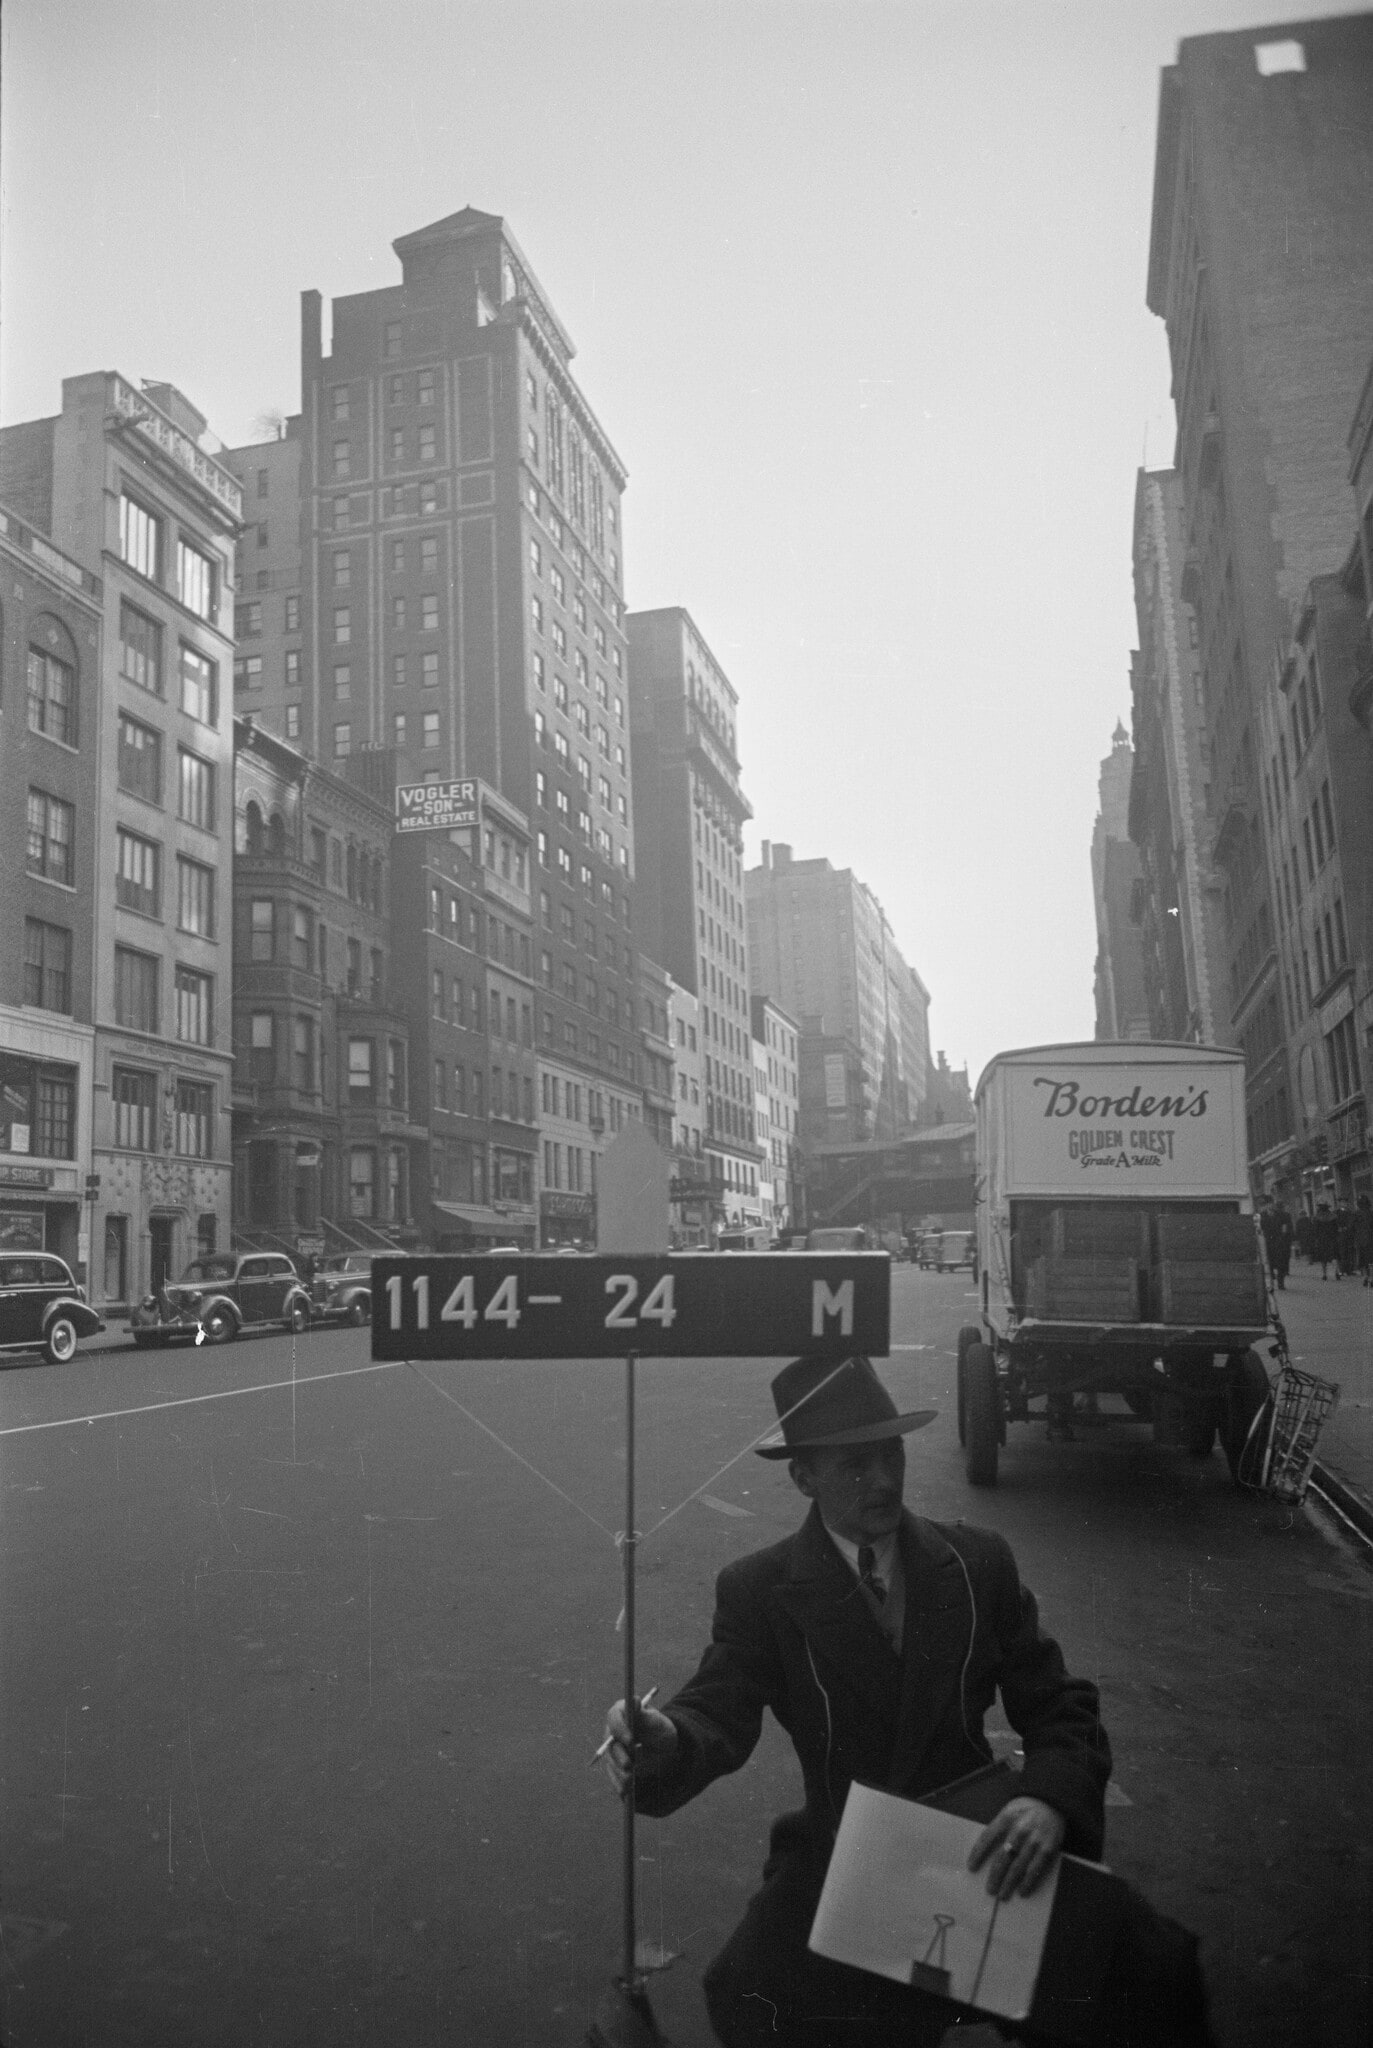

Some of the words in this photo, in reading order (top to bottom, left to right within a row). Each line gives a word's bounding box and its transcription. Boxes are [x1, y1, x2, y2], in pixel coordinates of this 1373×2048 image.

[401, 782, 475, 806] VOGLER
[401, 816, 432, 827] REAL
[433, 811, 476, 824] ESTATE
[1033, 1077, 1209, 1117] Borden's
[1069, 1129, 1123, 1160] GOLDEN
[1128, 1129, 1175, 1160] CREST
[1080, 1154, 1116, 1168] Grade
[1115, 1151, 1131, 1168] A
[1131, 1154, 1163, 1167] Milk
[604, 1274, 678, 1329] 24
[811, 1279, 855, 1337] M
